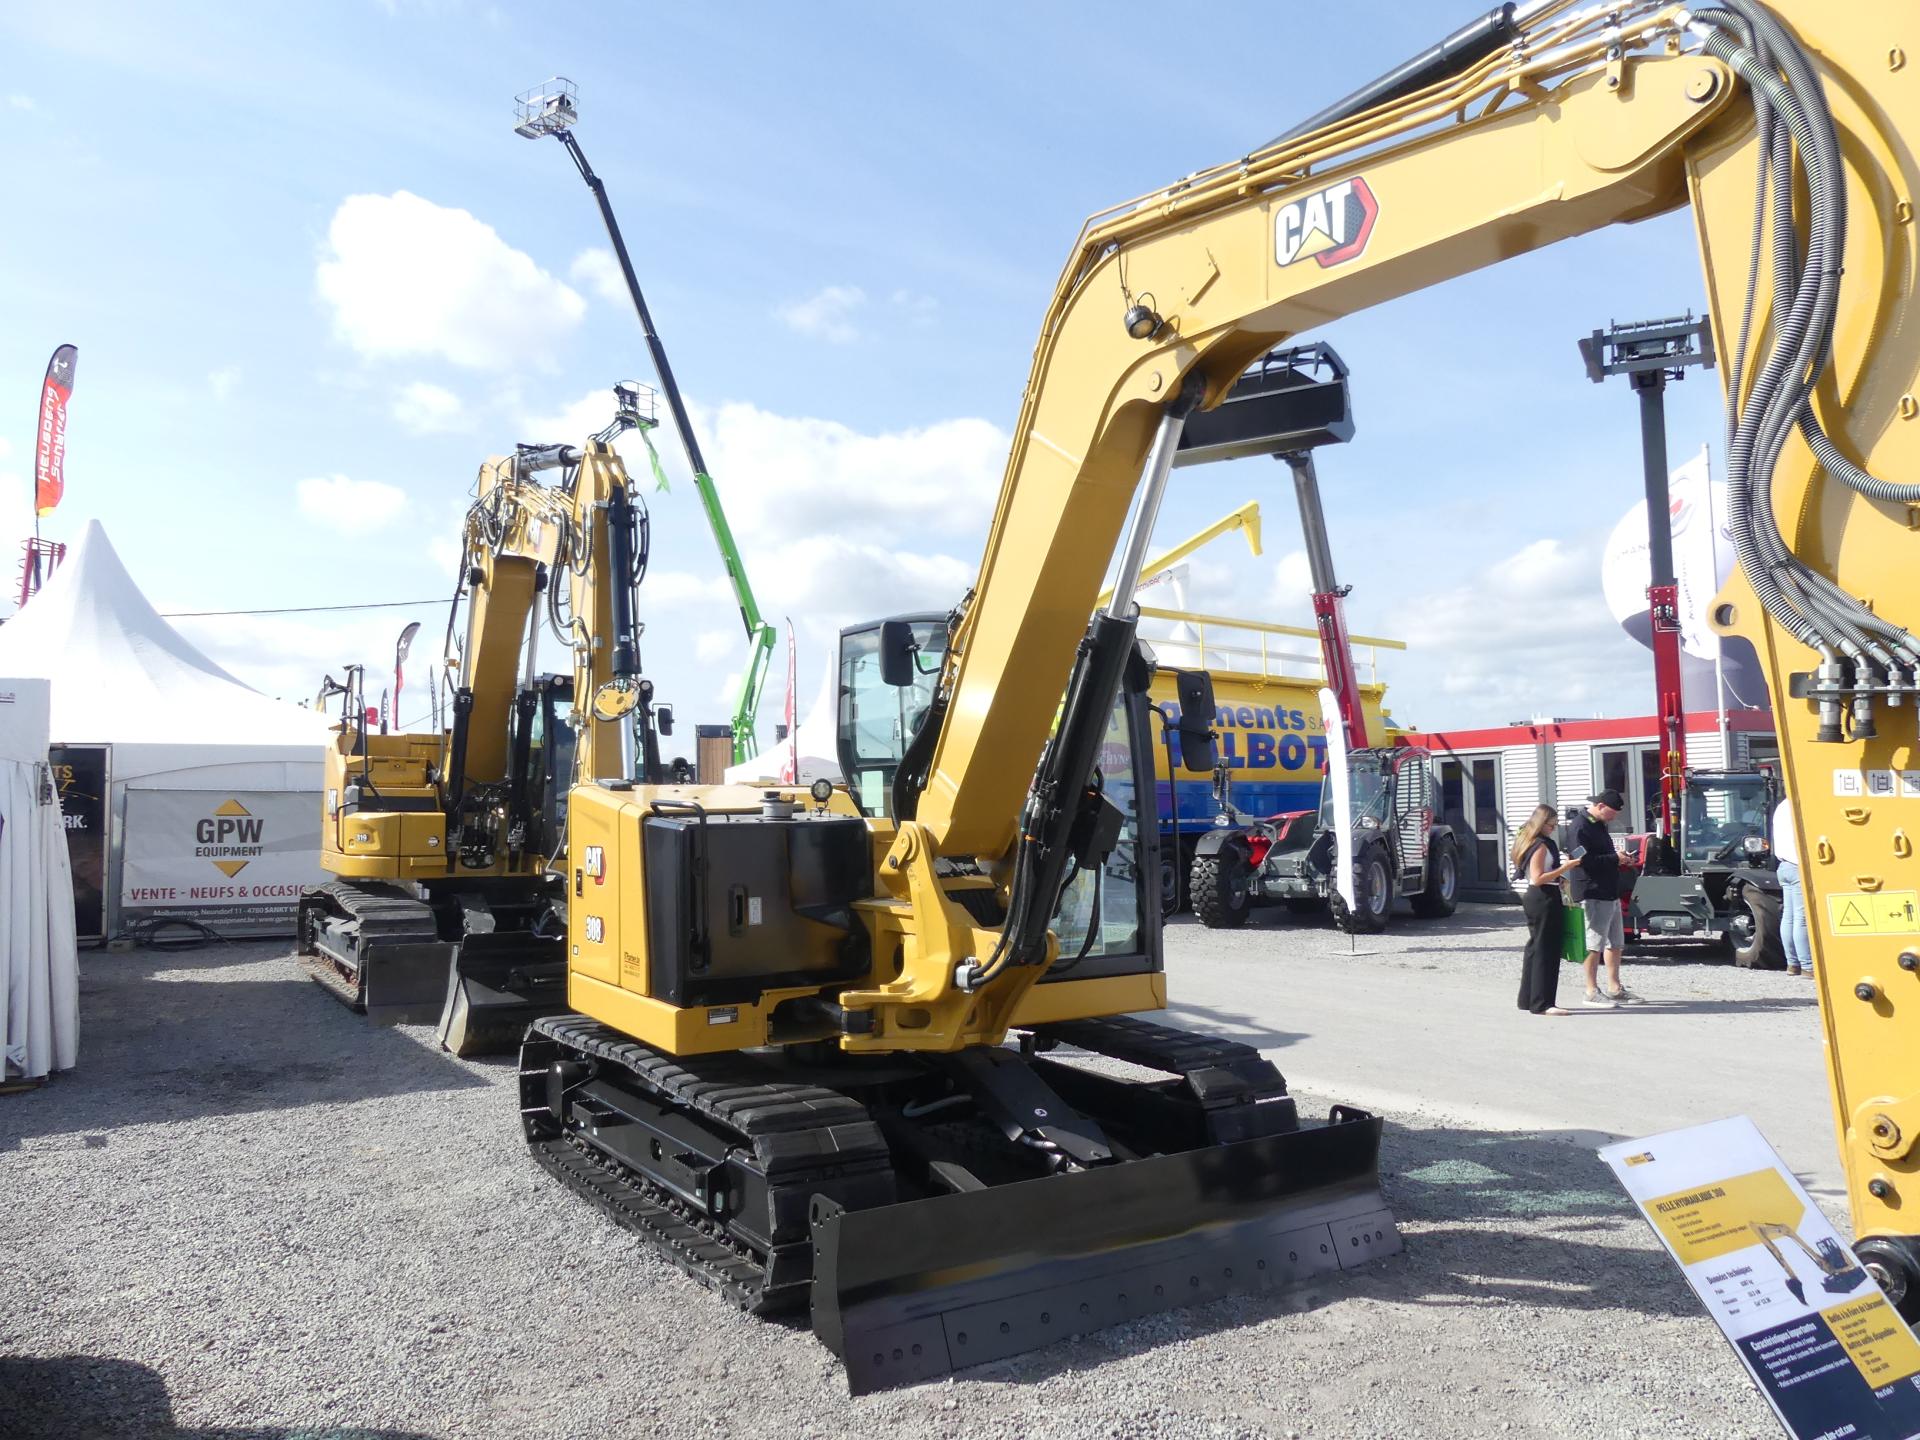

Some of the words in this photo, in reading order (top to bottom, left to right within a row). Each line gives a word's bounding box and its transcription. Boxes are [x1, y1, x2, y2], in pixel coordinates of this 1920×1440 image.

[1275, 180, 1352, 267] CAT
[1158, 701, 1306, 731] aments
[1161, 732, 1328, 771] TLBOT
[196, 818, 264, 844] GPW
[195, 846, 264, 858] EQUIPMENT
[585, 845, 602, 877] CAT
[131, 888, 177, 900] VENTE
[190, 886, 234, 899] NEUFS
[238, 886, 248, 898] &
[585, 914, 602, 943] 308
[1656, 1201, 1677, 1214] PELLE
